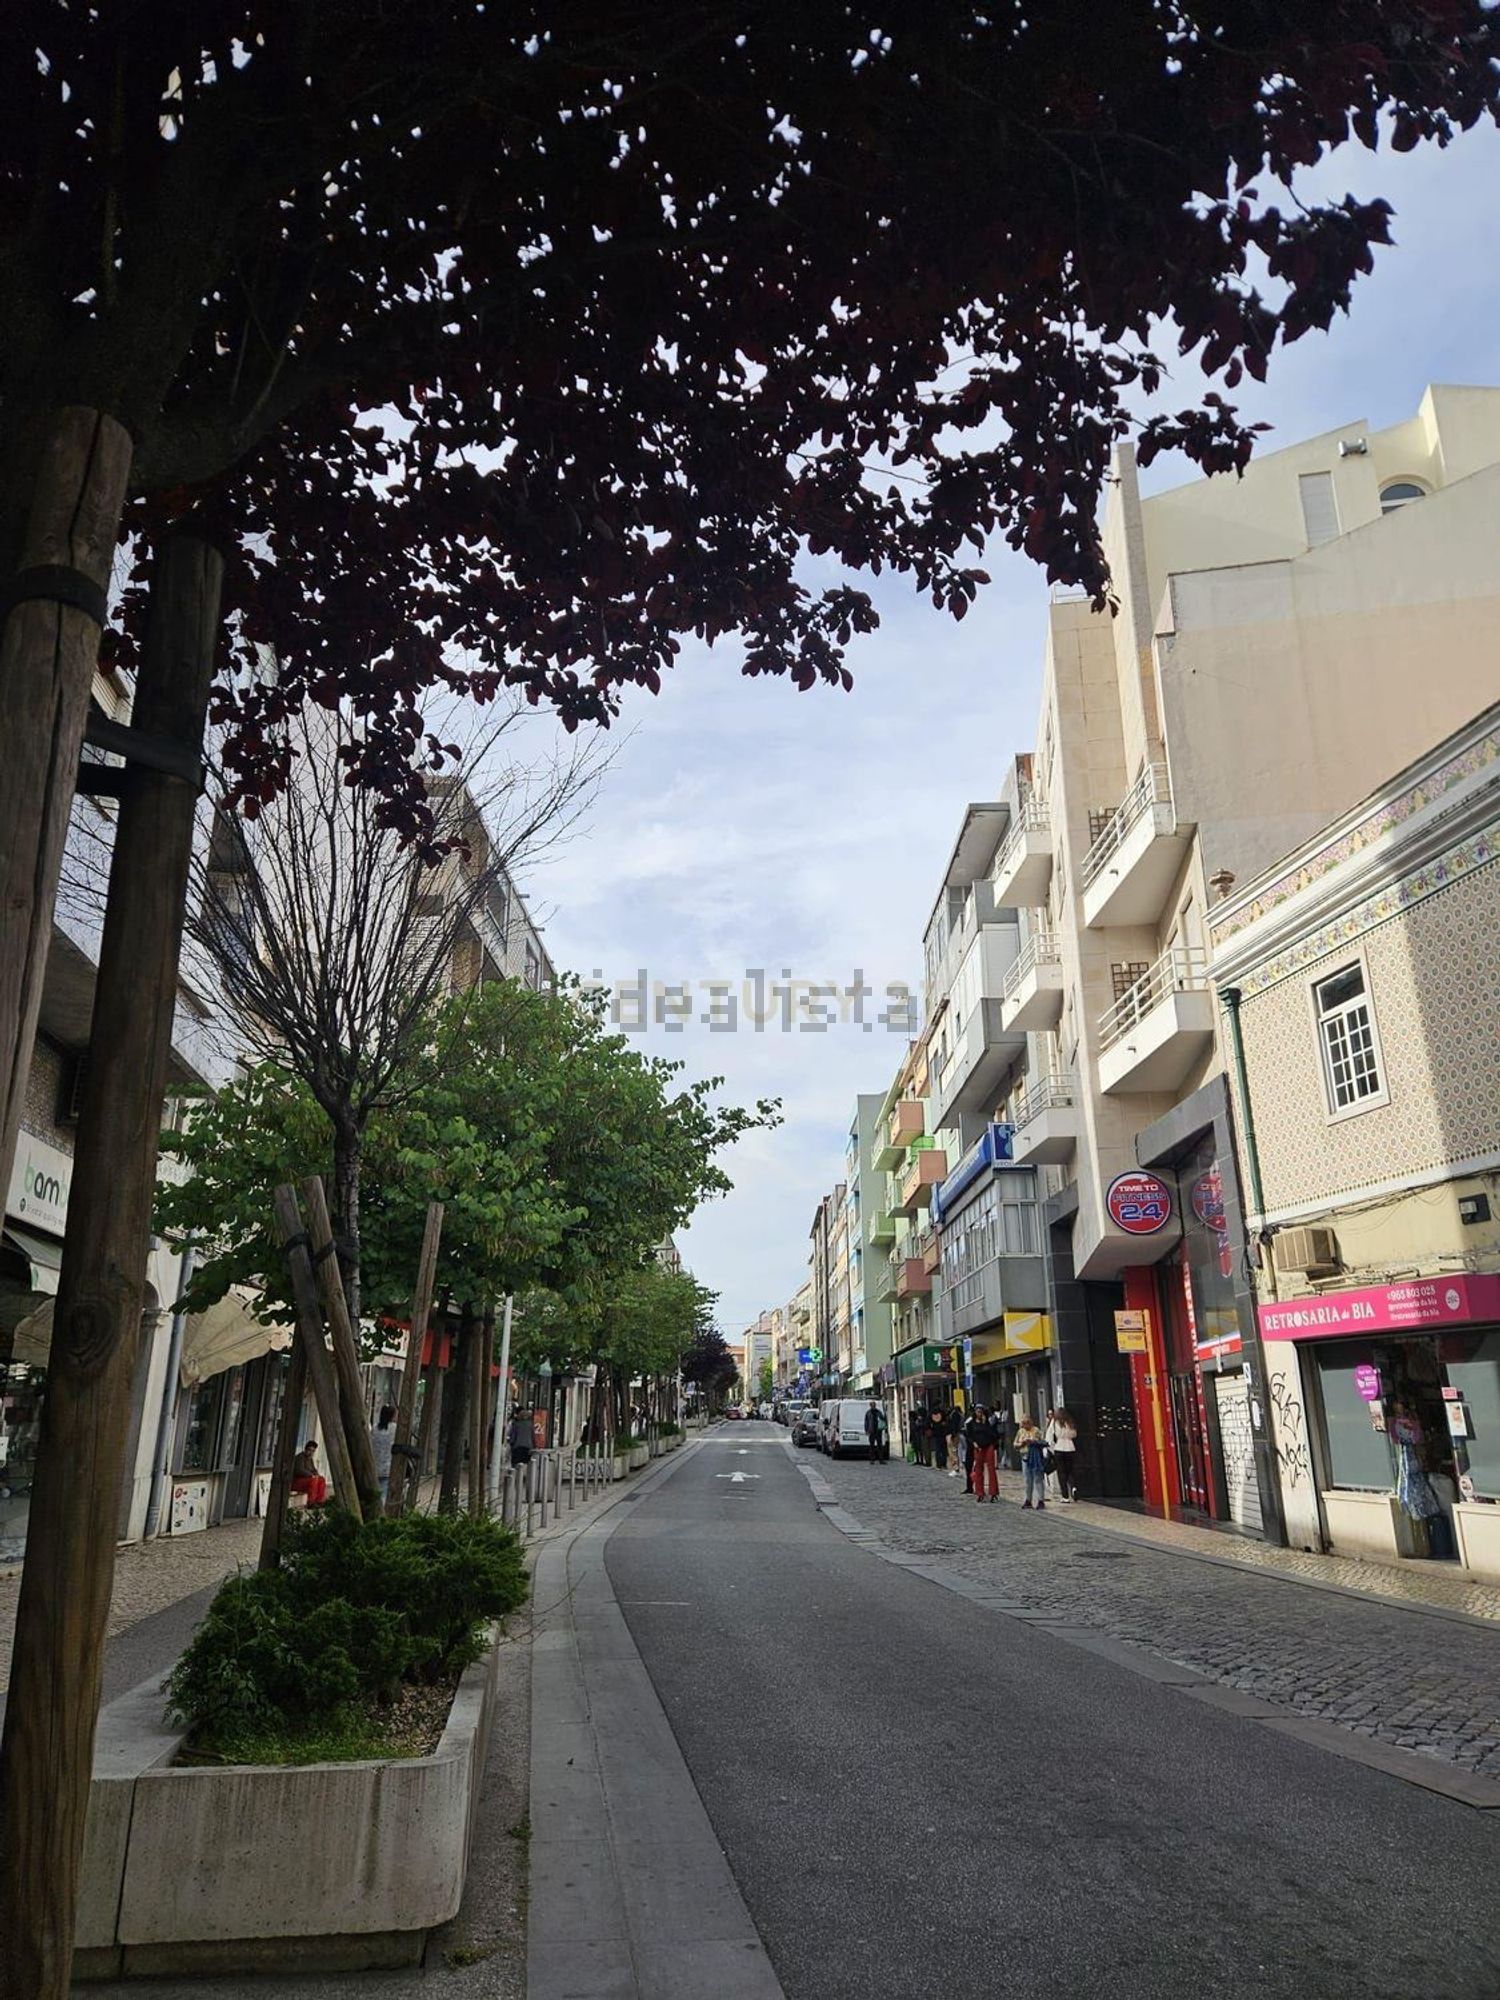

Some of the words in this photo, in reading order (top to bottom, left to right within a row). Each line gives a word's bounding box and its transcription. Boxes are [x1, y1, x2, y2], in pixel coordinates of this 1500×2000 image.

[1144, 1183, 1159, 1191] TO
[1119, 1201, 1164, 1222] 24
[1264, 1306, 1341, 1331] RETROSARIA
[1352, 1301, 1376, 1320] BIA
